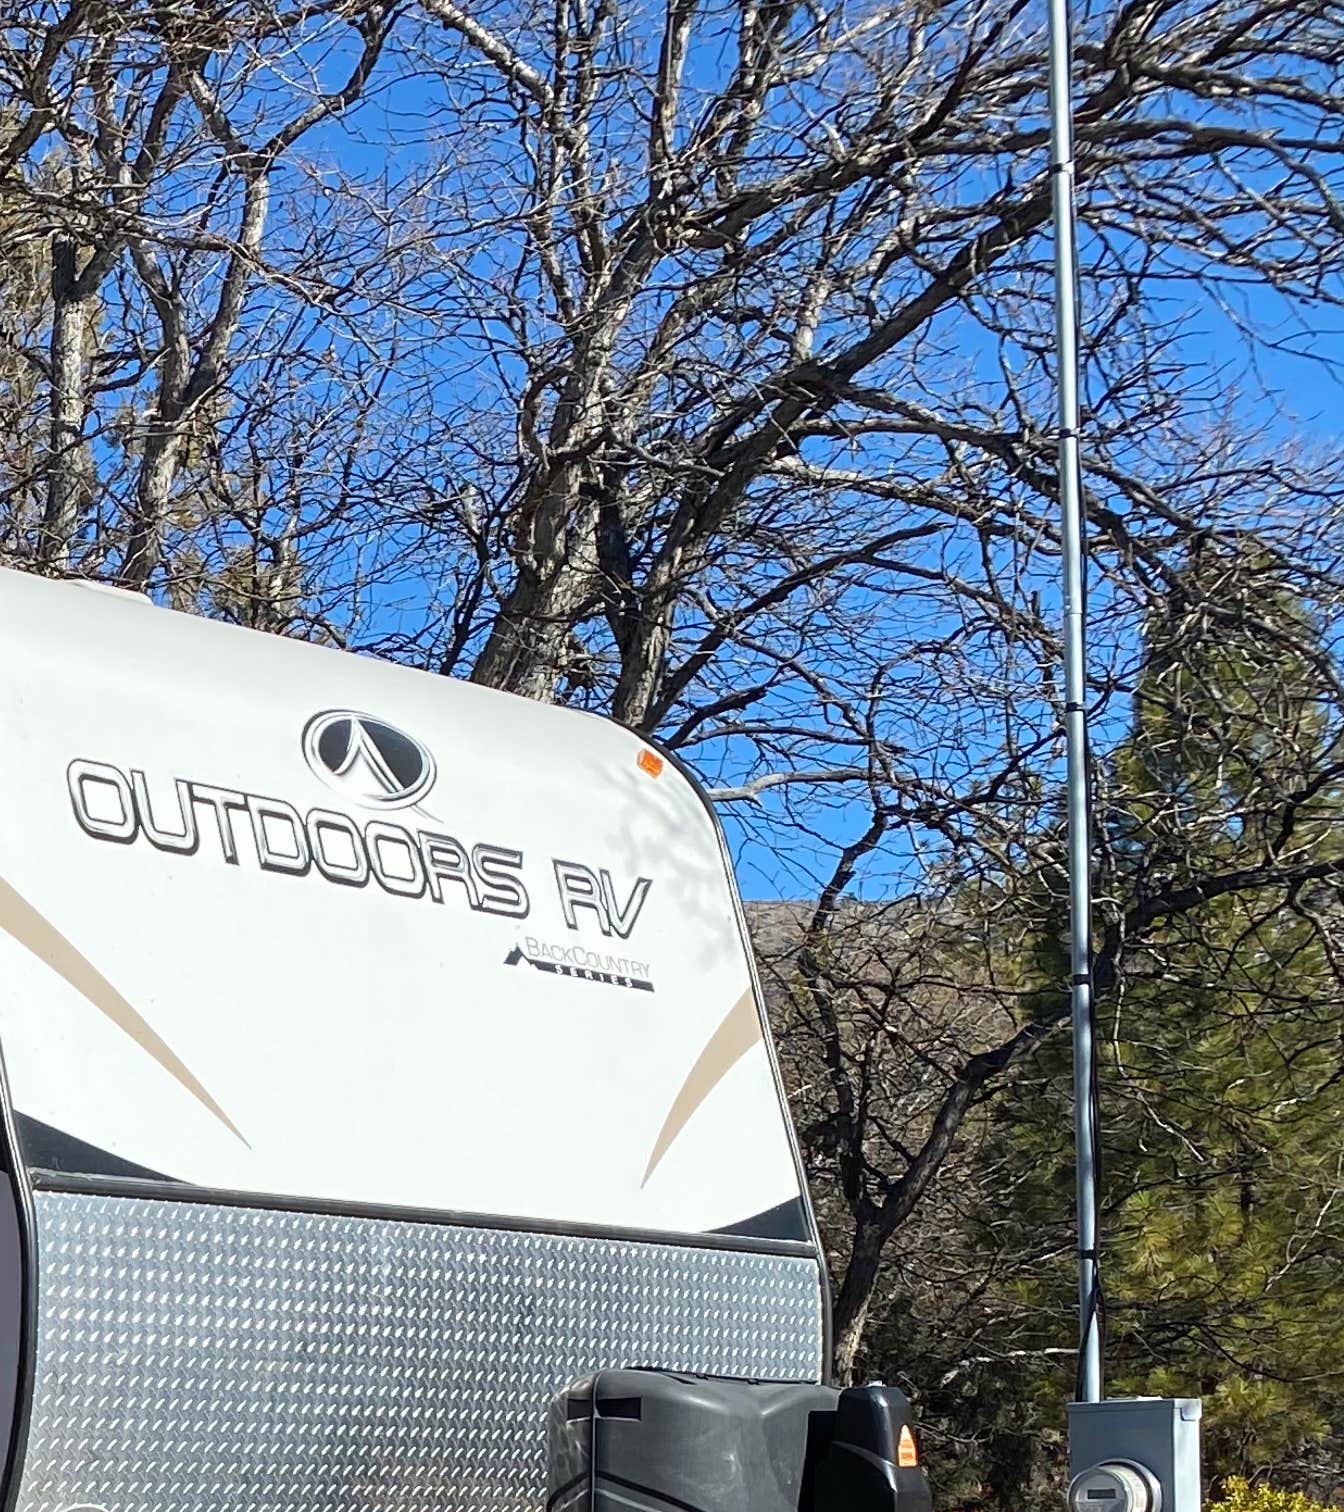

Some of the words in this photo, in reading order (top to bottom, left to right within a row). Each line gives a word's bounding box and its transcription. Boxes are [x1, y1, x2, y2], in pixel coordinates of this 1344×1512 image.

[67, 758, 530, 919] OUTDOORS
[552, 859, 653, 939] RV
[554, 964, 634, 988] SERIES
